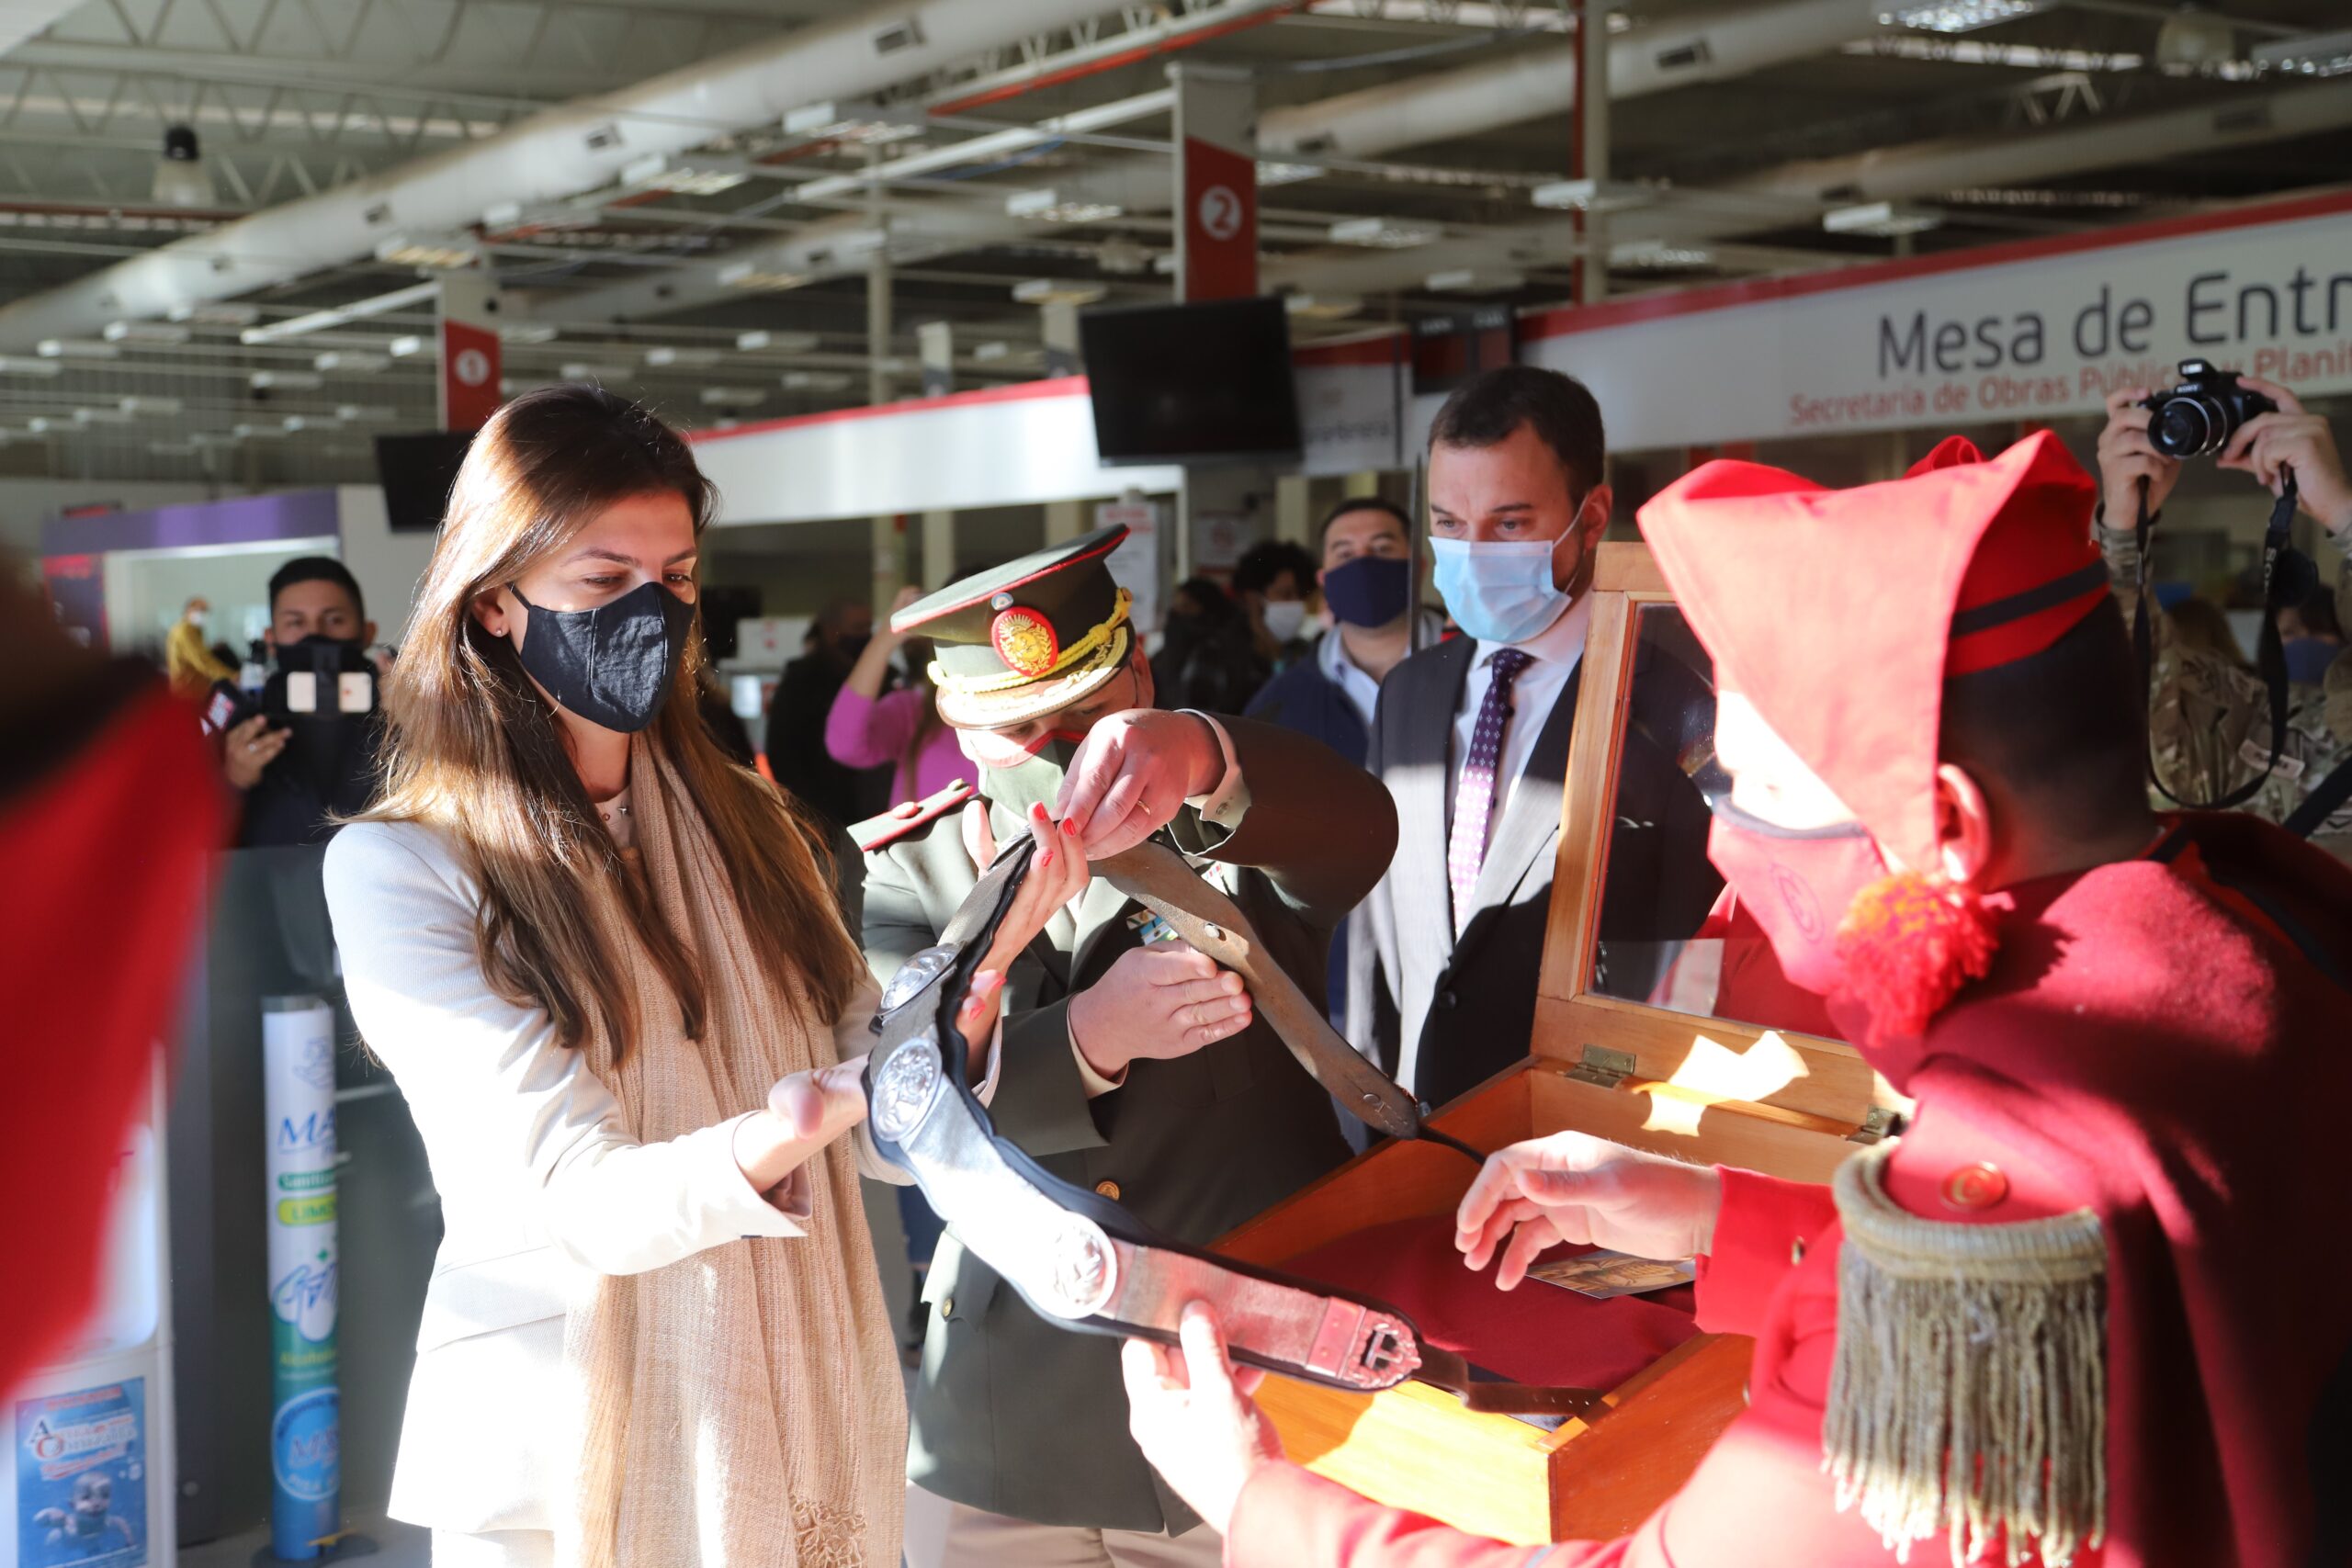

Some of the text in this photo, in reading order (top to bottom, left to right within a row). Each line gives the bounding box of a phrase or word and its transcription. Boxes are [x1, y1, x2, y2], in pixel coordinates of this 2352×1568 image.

[1212, 193, 1233, 230] 2
[1879, 265, 2352, 378] Mesa de Entr
[1933, 378, 1969, 413] de
[1979, 373, 2071, 411] Obras
